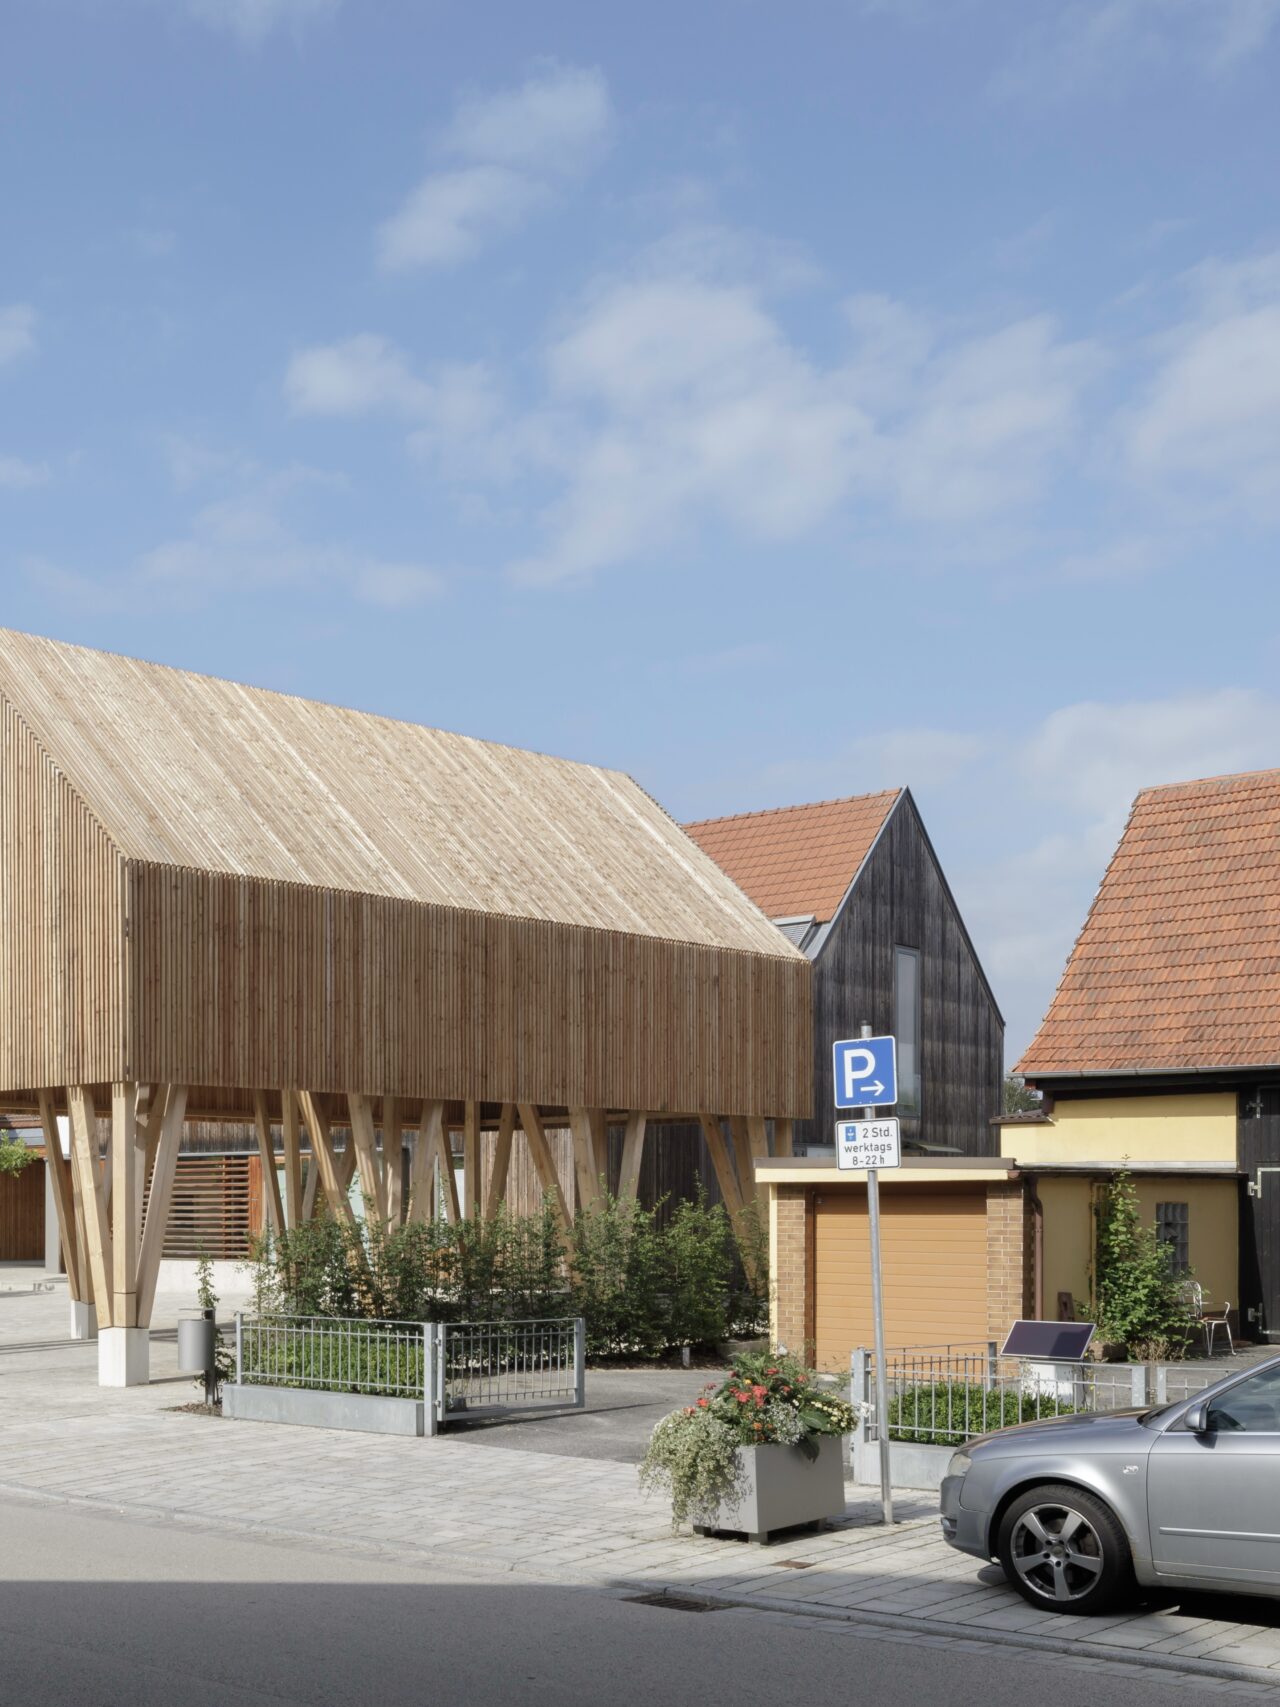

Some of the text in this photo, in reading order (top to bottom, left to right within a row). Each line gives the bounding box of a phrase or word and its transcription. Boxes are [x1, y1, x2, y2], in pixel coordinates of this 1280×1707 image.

[843, 1048, 876, 1099] P
[862, 1126, 893, 1138] 2 Std.
[844, 1142, 893, 1154] werktags
[879, 1154, 885, 1165] h
